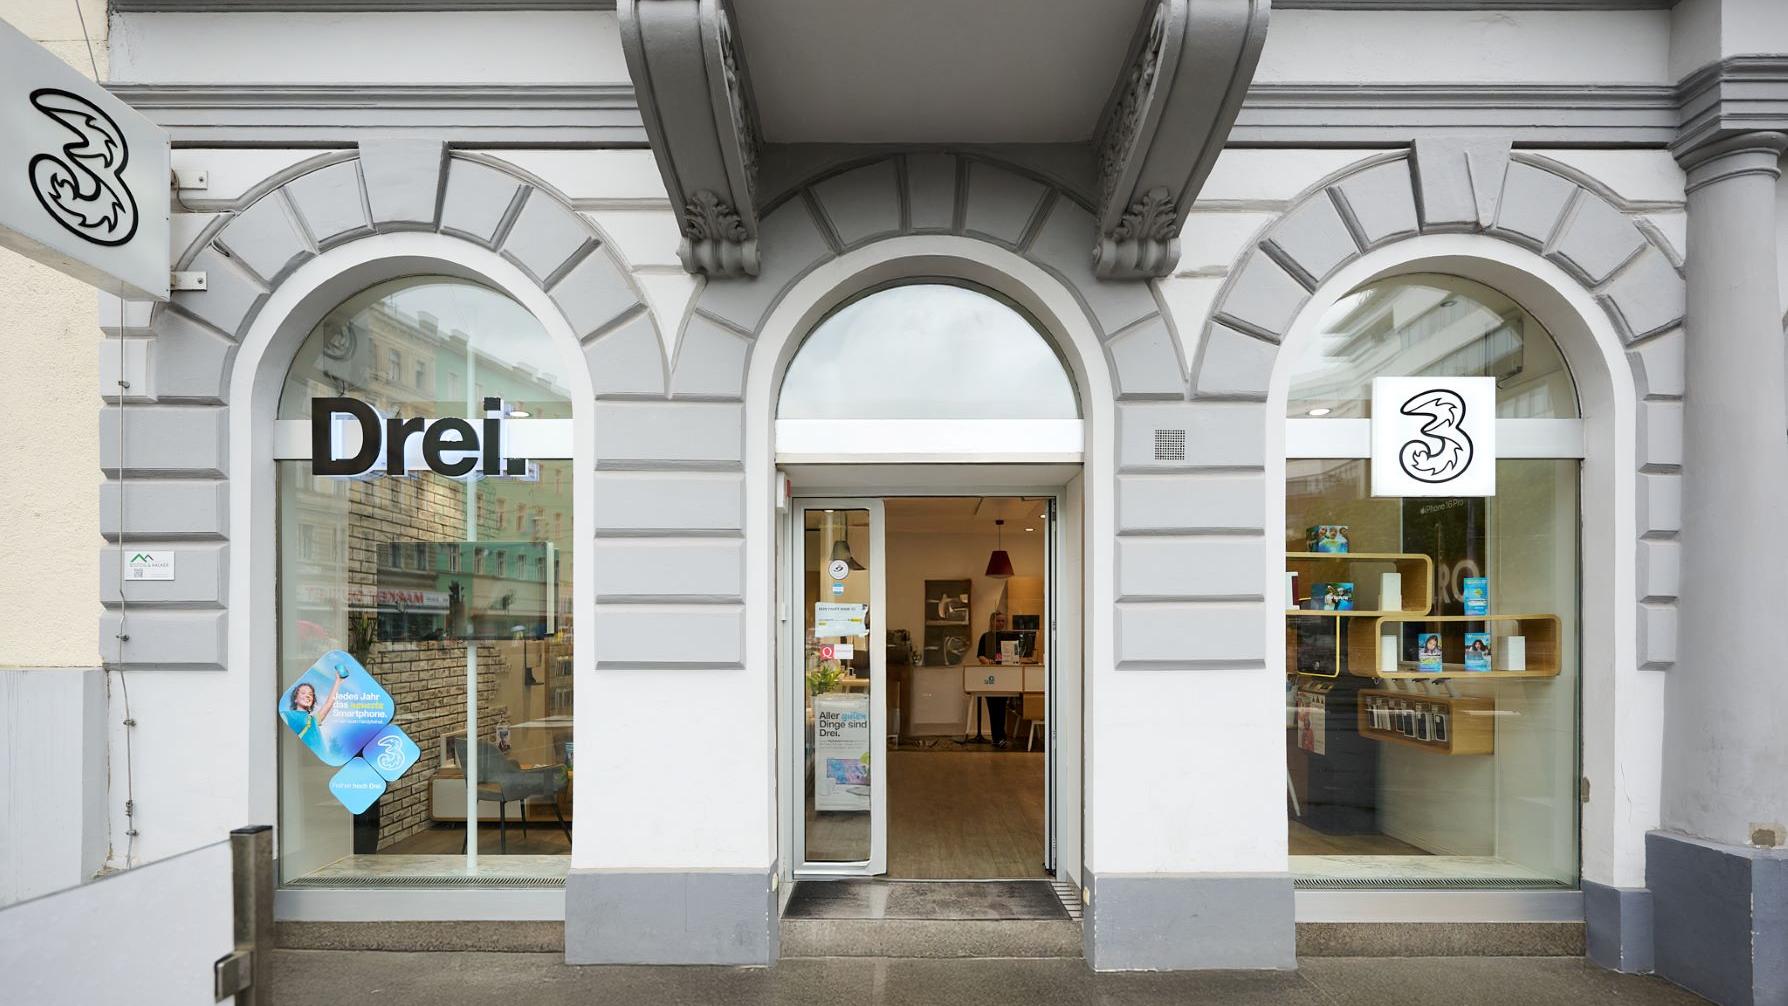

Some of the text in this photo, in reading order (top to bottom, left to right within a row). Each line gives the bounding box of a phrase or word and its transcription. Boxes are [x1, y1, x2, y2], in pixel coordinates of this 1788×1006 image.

[29, 88, 139, 246] 3
[312, 397, 526, 477] Drei.
[1399, 389, 1473, 483] 3
[360, 692, 380, 700] Jahr
[333, 710, 387, 719] Smartphone.
[819, 711, 840, 720] Aller
[819, 720, 868, 730] Dinge sind
[819, 729, 841, 737] Drei.
